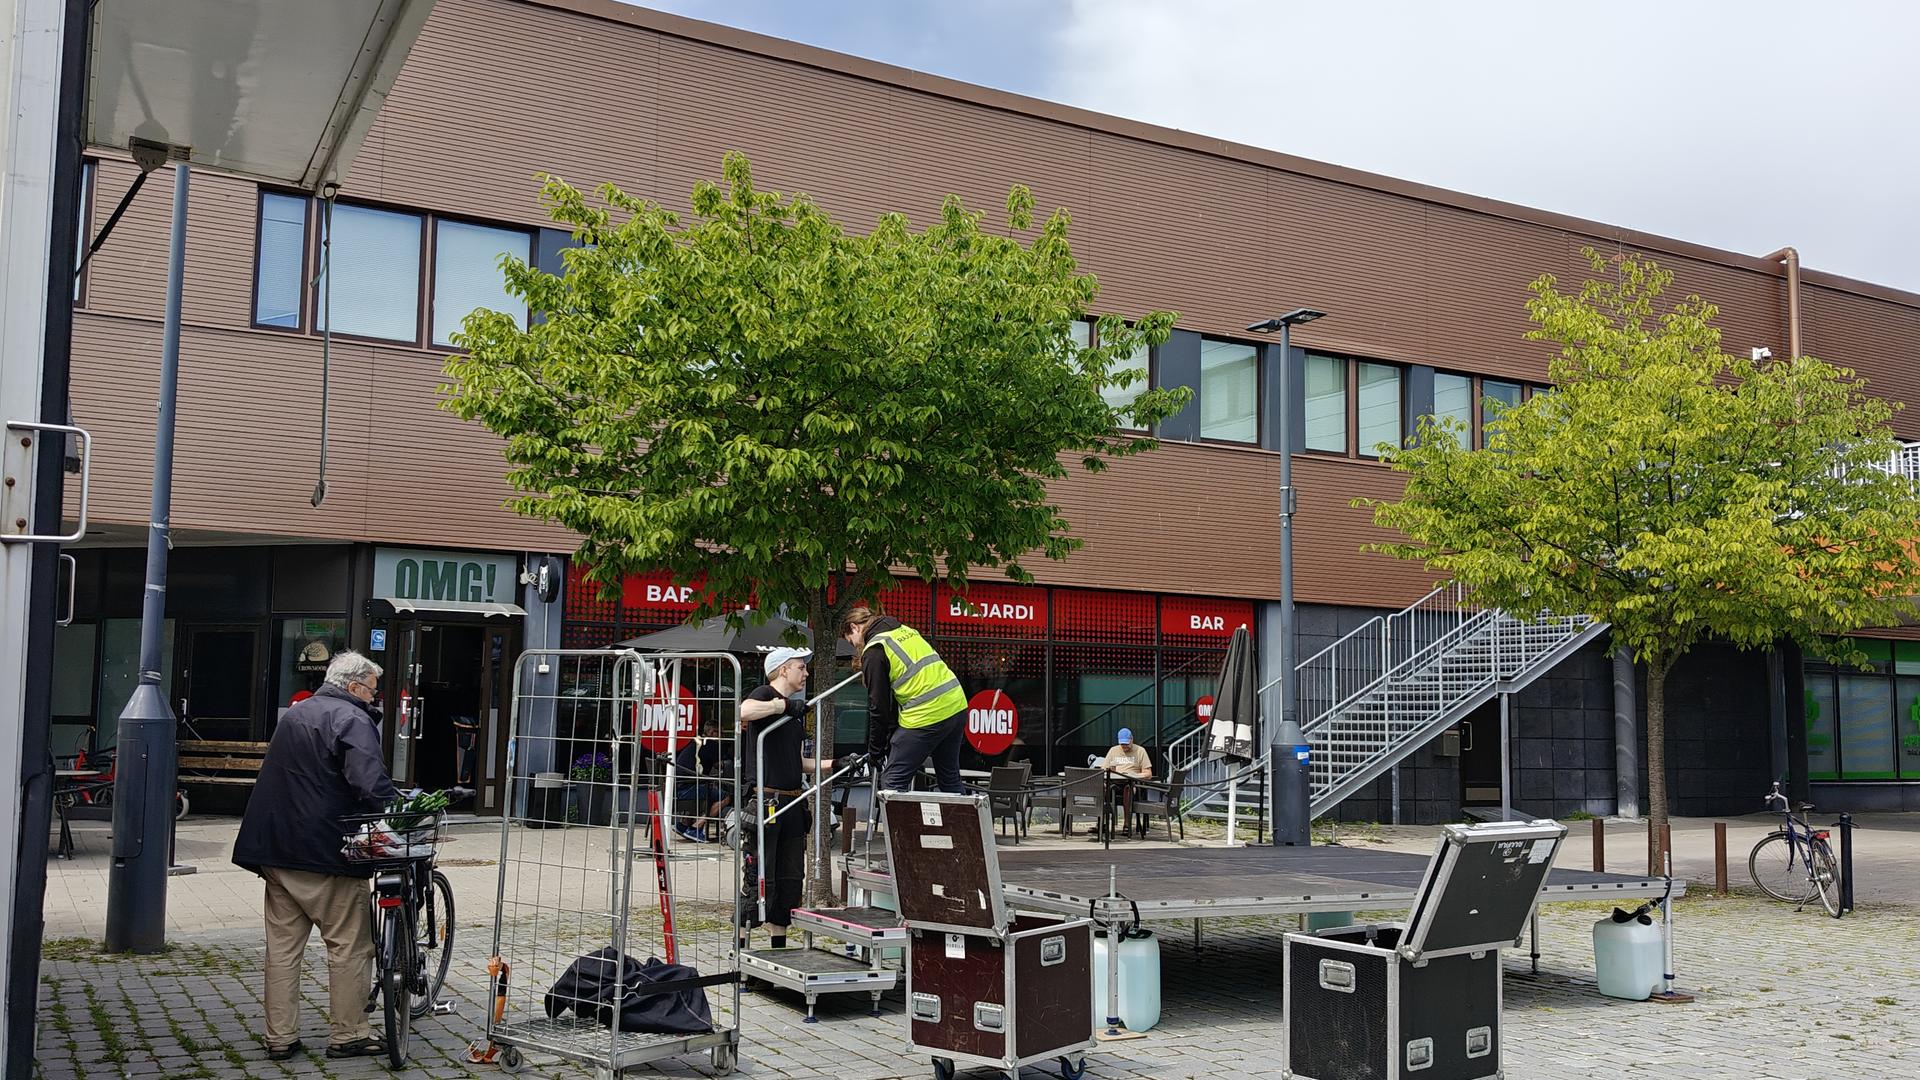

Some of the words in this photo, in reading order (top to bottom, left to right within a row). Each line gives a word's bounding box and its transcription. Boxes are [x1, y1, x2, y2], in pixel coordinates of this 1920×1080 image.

[395, 558, 497, 603] OMG!
[646, 584, 695, 604] BAR
[1190, 615, 1224, 630] BAR
[1198, 704, 1213, 717] OM
[968, 708, 1013, 735] OMG!
